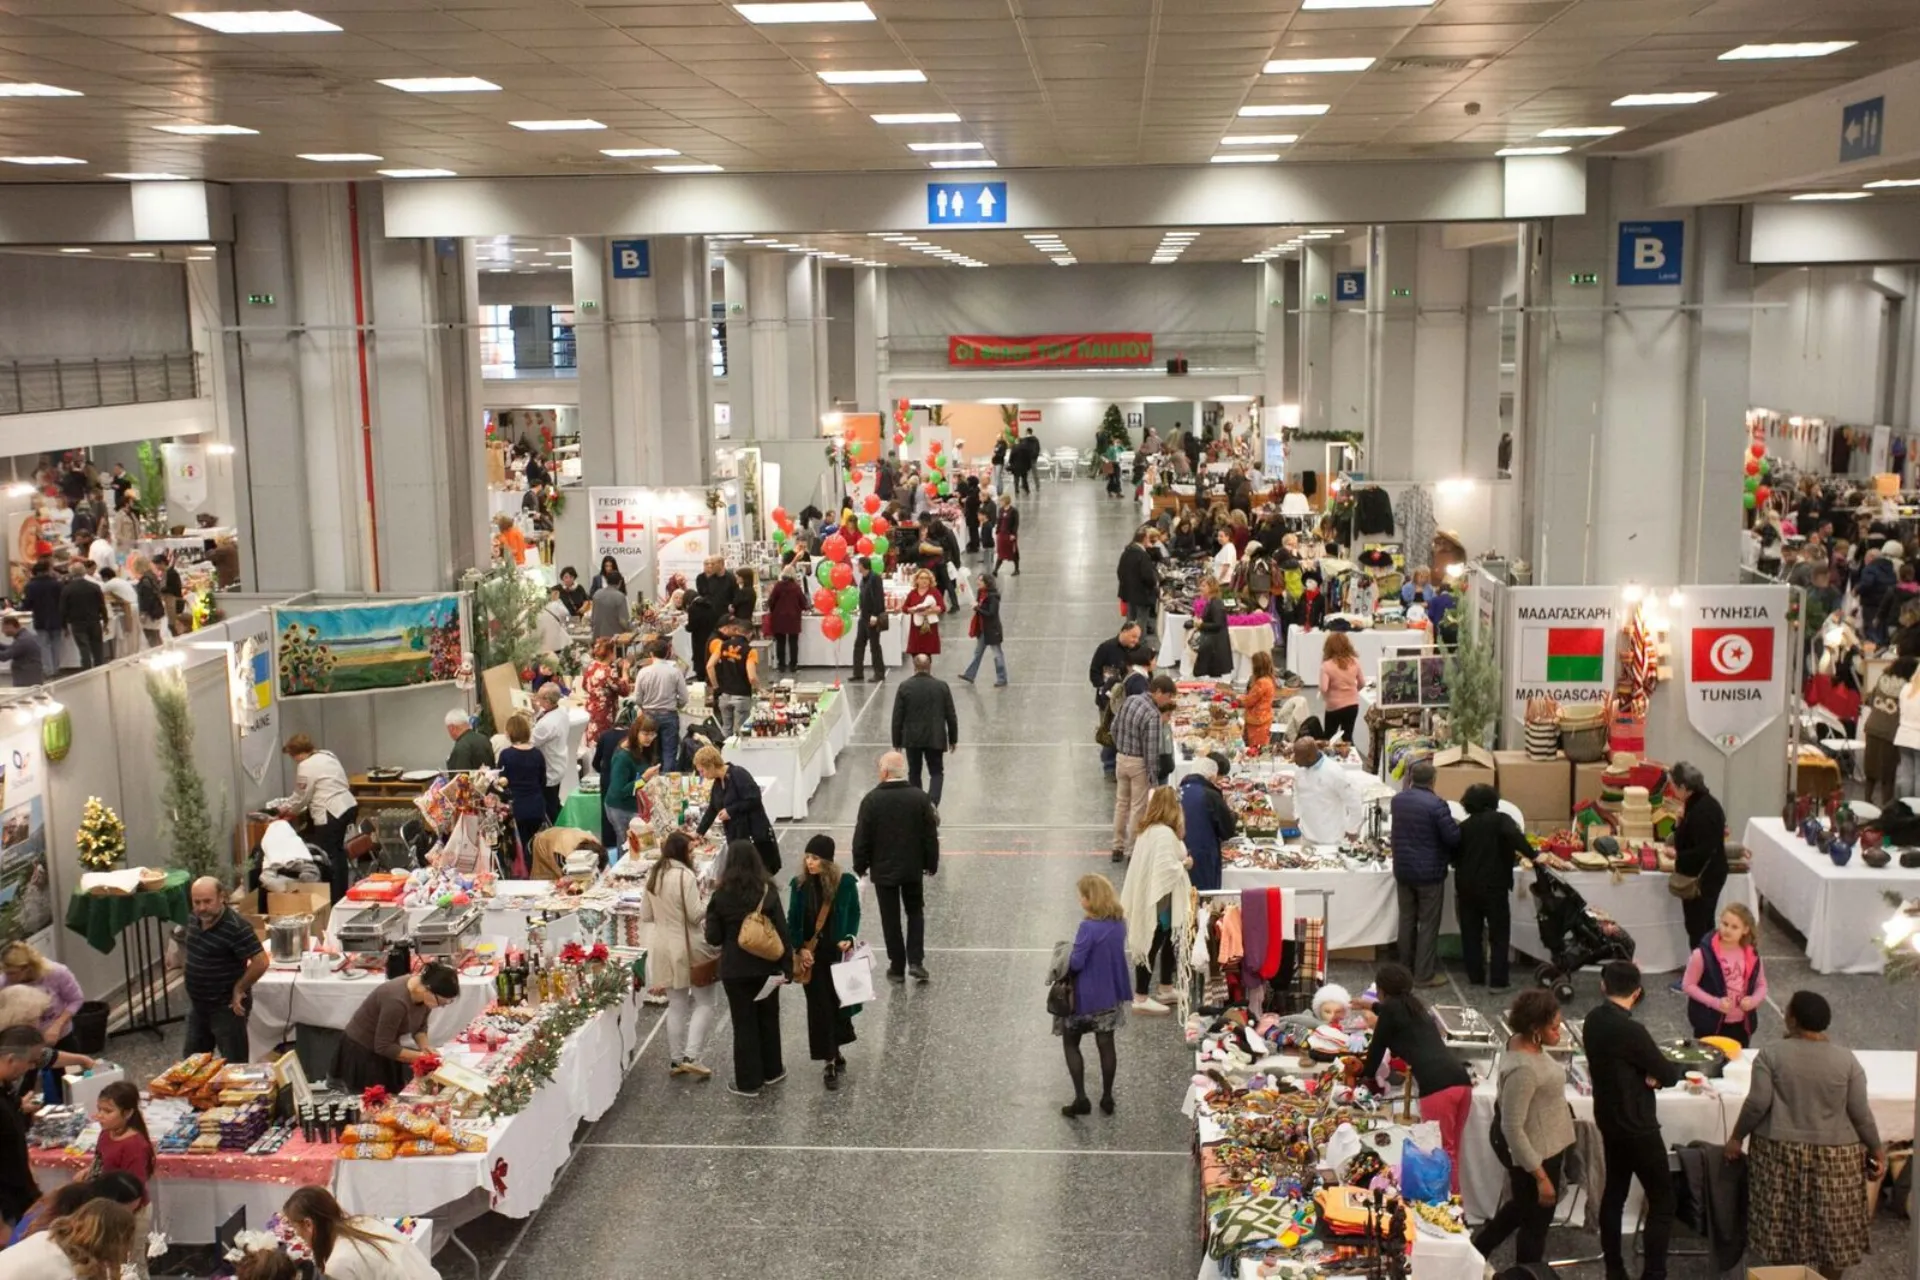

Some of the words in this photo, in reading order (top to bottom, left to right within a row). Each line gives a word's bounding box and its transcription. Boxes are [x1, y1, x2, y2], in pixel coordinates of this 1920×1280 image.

[621, 250, 640, 269] B
[1634, 238, 1666, 270] B
[1343, 279, 1358, 294] B
[599, 547, 642, 555] GEORGIA
[1518, 607, 1611, 619] ΜΑΔΑΓΑΣΚΑΡΗ
[1700, 606, 1769, 619] ΤΥΝΗΣΙΑ
[1700, 688, 1762, 701] TUNISIA
